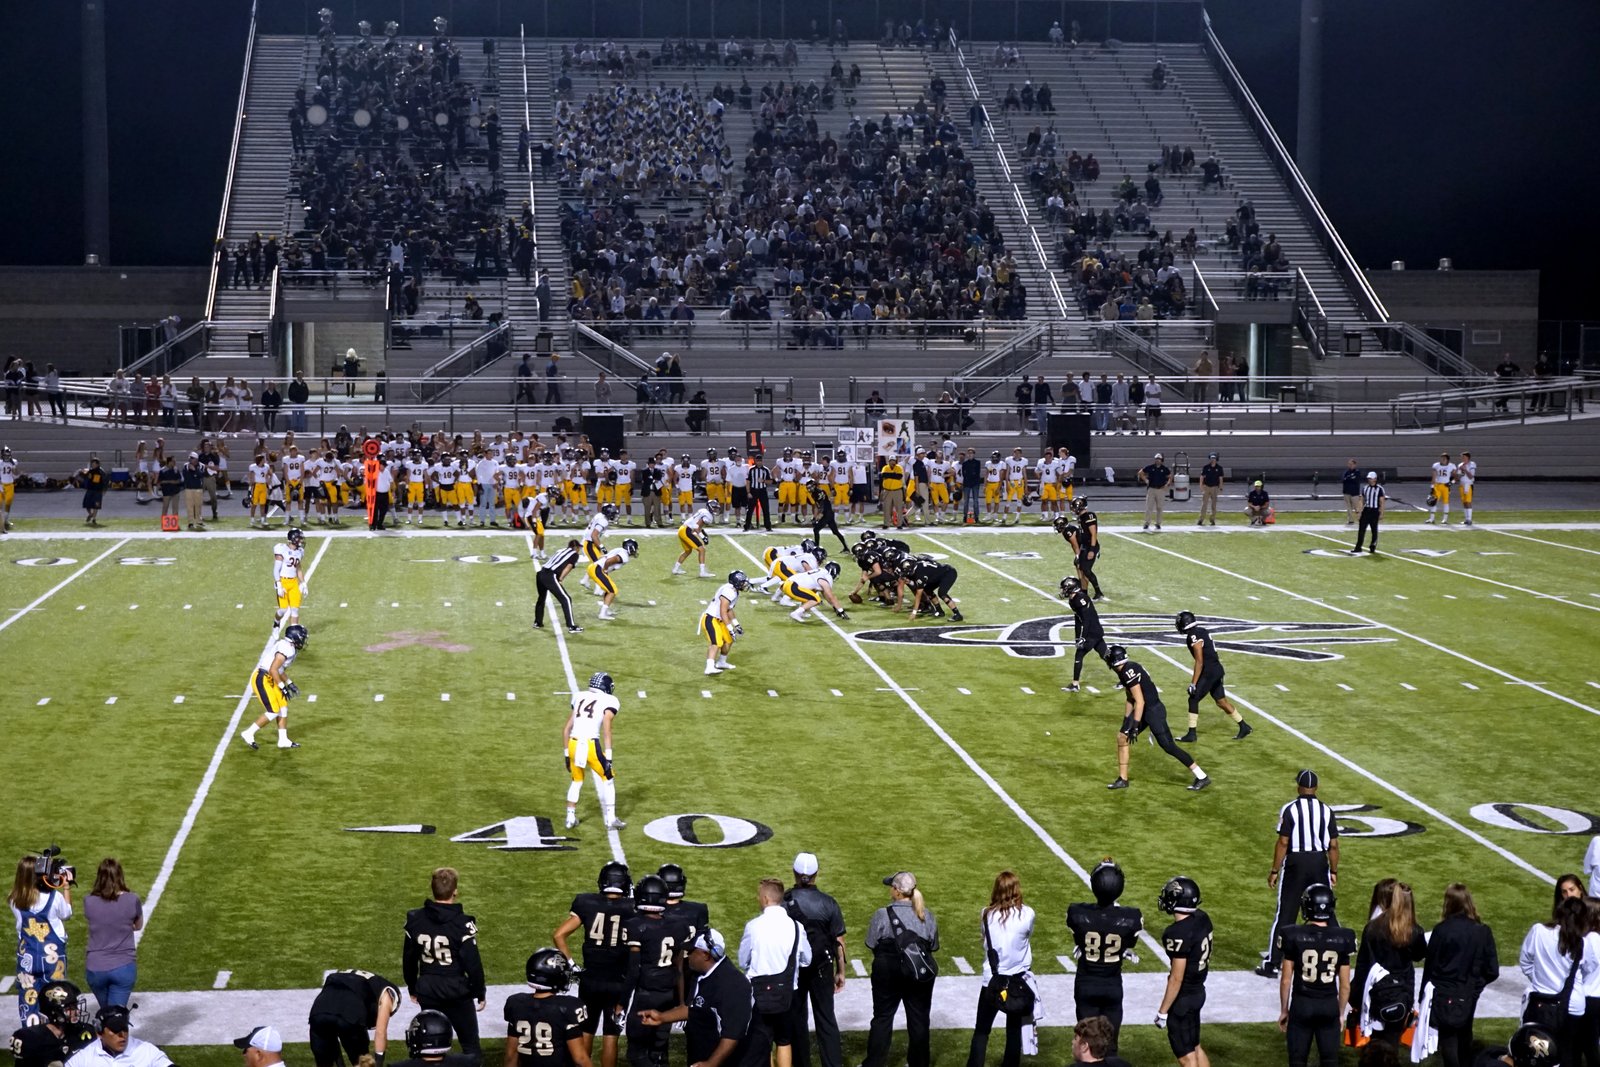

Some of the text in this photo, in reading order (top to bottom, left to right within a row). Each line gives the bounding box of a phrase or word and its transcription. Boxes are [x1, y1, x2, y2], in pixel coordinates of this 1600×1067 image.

[750, 431, 758, 447] 1
[709, 467, 720, 475] 92
[837, 466, 847, 475] 91
[164, 516, 178, 528] 30
[1190, 634, 1198, 643] 2
[1125, 668, 1136, 679] 12
[576, 698, 598, 719] 14
[589, 911, 621, 947] 41
[621, 927, 628, 941] 6
[657, 936, 675, 968] 6
[1084, 930, 1122, 964] 82
[1166, 938, 1184, 953] 27
[1301, 948, 1339, 984] 83
[516, 1020, 555, 1057] 28
